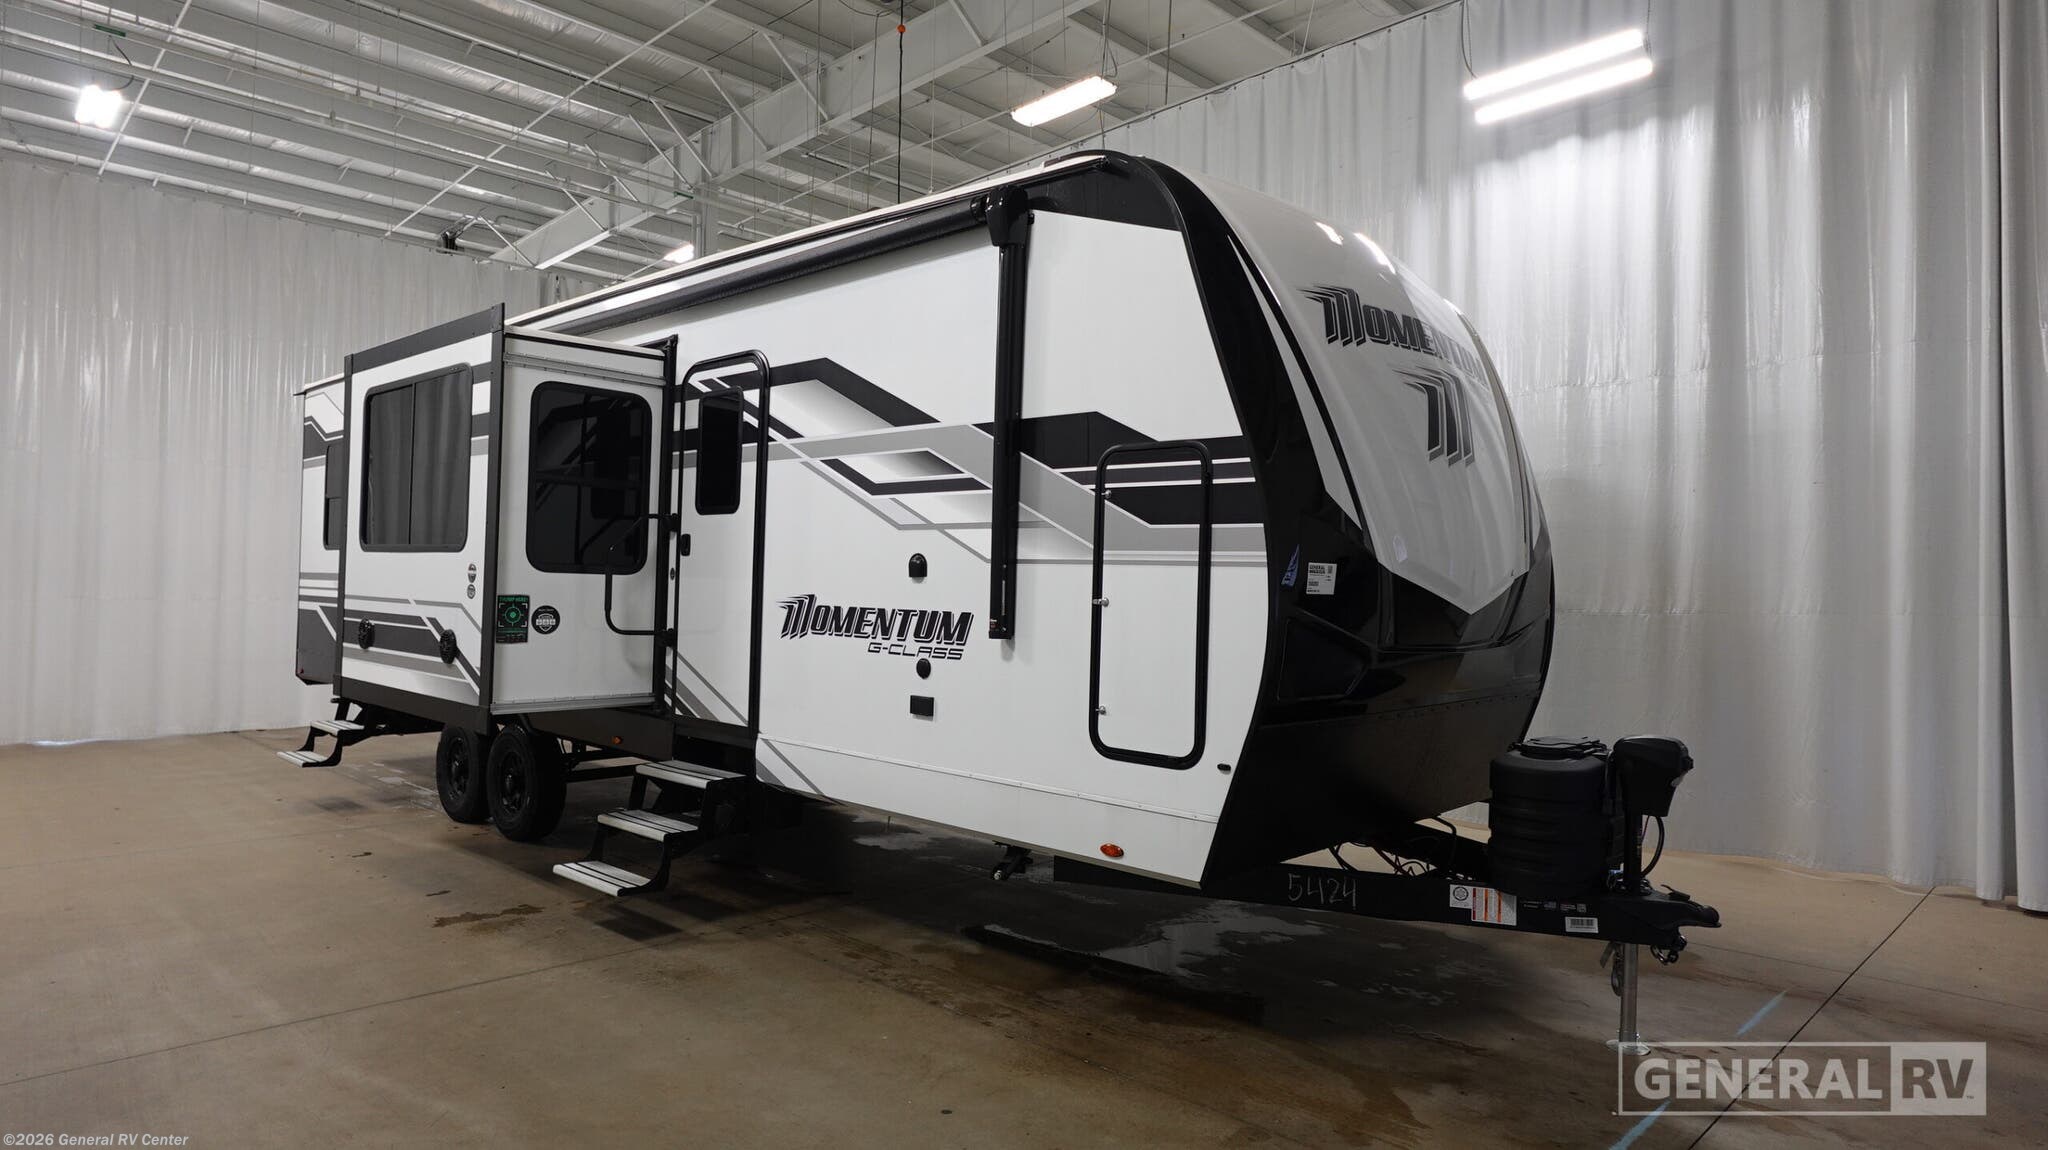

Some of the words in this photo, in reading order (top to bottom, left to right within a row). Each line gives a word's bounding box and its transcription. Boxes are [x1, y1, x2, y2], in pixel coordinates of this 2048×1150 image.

[777, 593, 974, 646] MOMENTUM
[867, 643, 964, 660] G-CLASS
[1288, 873, 1357, 910] 5424
